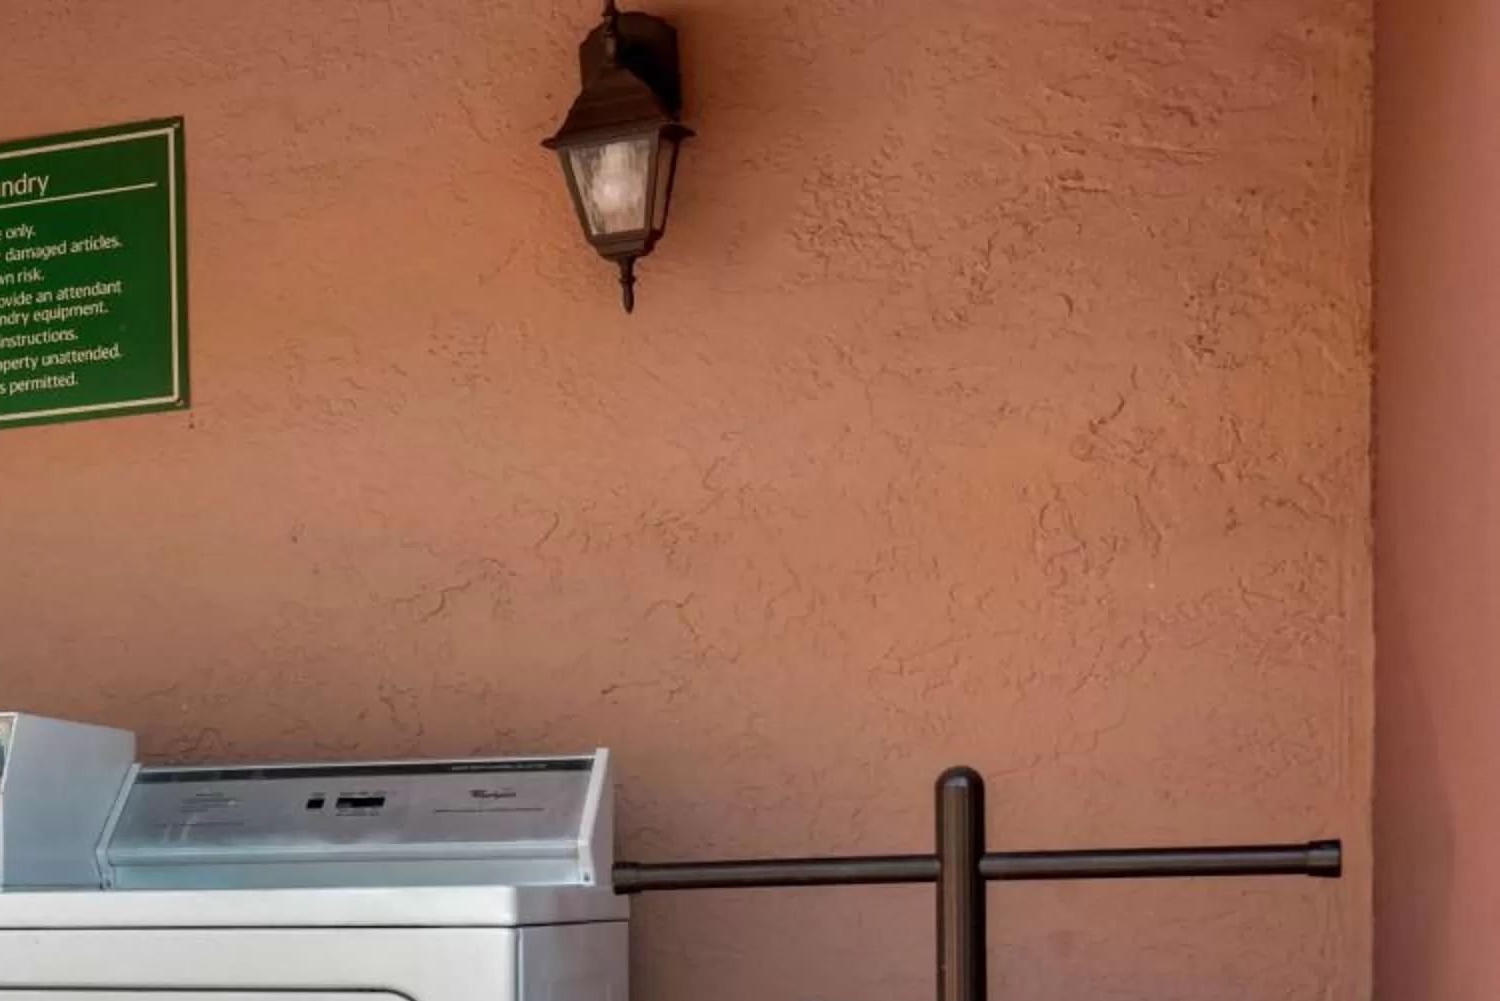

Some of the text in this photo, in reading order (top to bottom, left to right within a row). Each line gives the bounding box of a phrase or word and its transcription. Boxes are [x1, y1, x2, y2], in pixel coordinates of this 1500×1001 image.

[5, 224, 36, 240] only.
[5, 240, 67, 262] damaged
[70, 235, 123, 253] articles.
[17, 267, 45, 283] risk.
[35, 290, 53, 303] an
[56, 280, 123, 300] attendant
[33, 301, 109, 324] equipment.
[0, 328, 78, 349] instructions.
[41, 343, 123, 367] unattended.
[9, 372, 78, 396] permitted.
